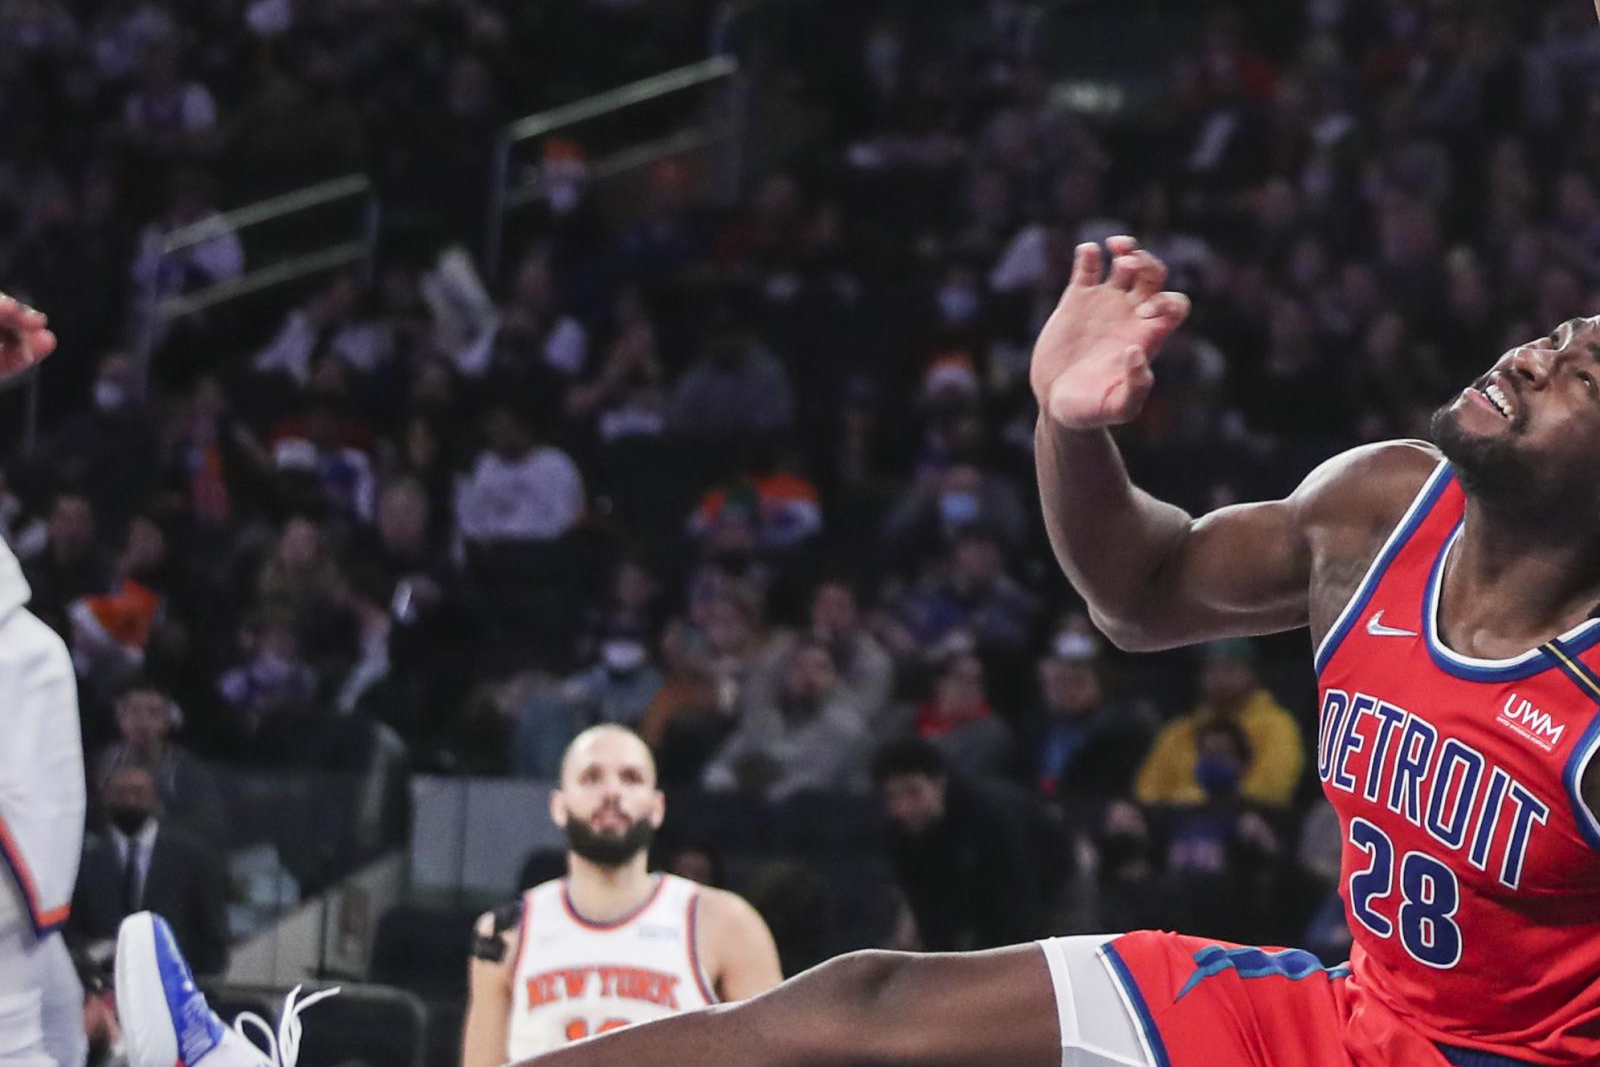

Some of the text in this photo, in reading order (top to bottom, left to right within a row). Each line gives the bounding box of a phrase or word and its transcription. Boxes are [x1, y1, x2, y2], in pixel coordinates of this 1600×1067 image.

[1503, 693, 1566, 745] UWM
[1318, 688, 1550, 891] DETROIT
[1348, 815, 1463, 970] 28
[526, 964, 682, 1011] NEW YORK
